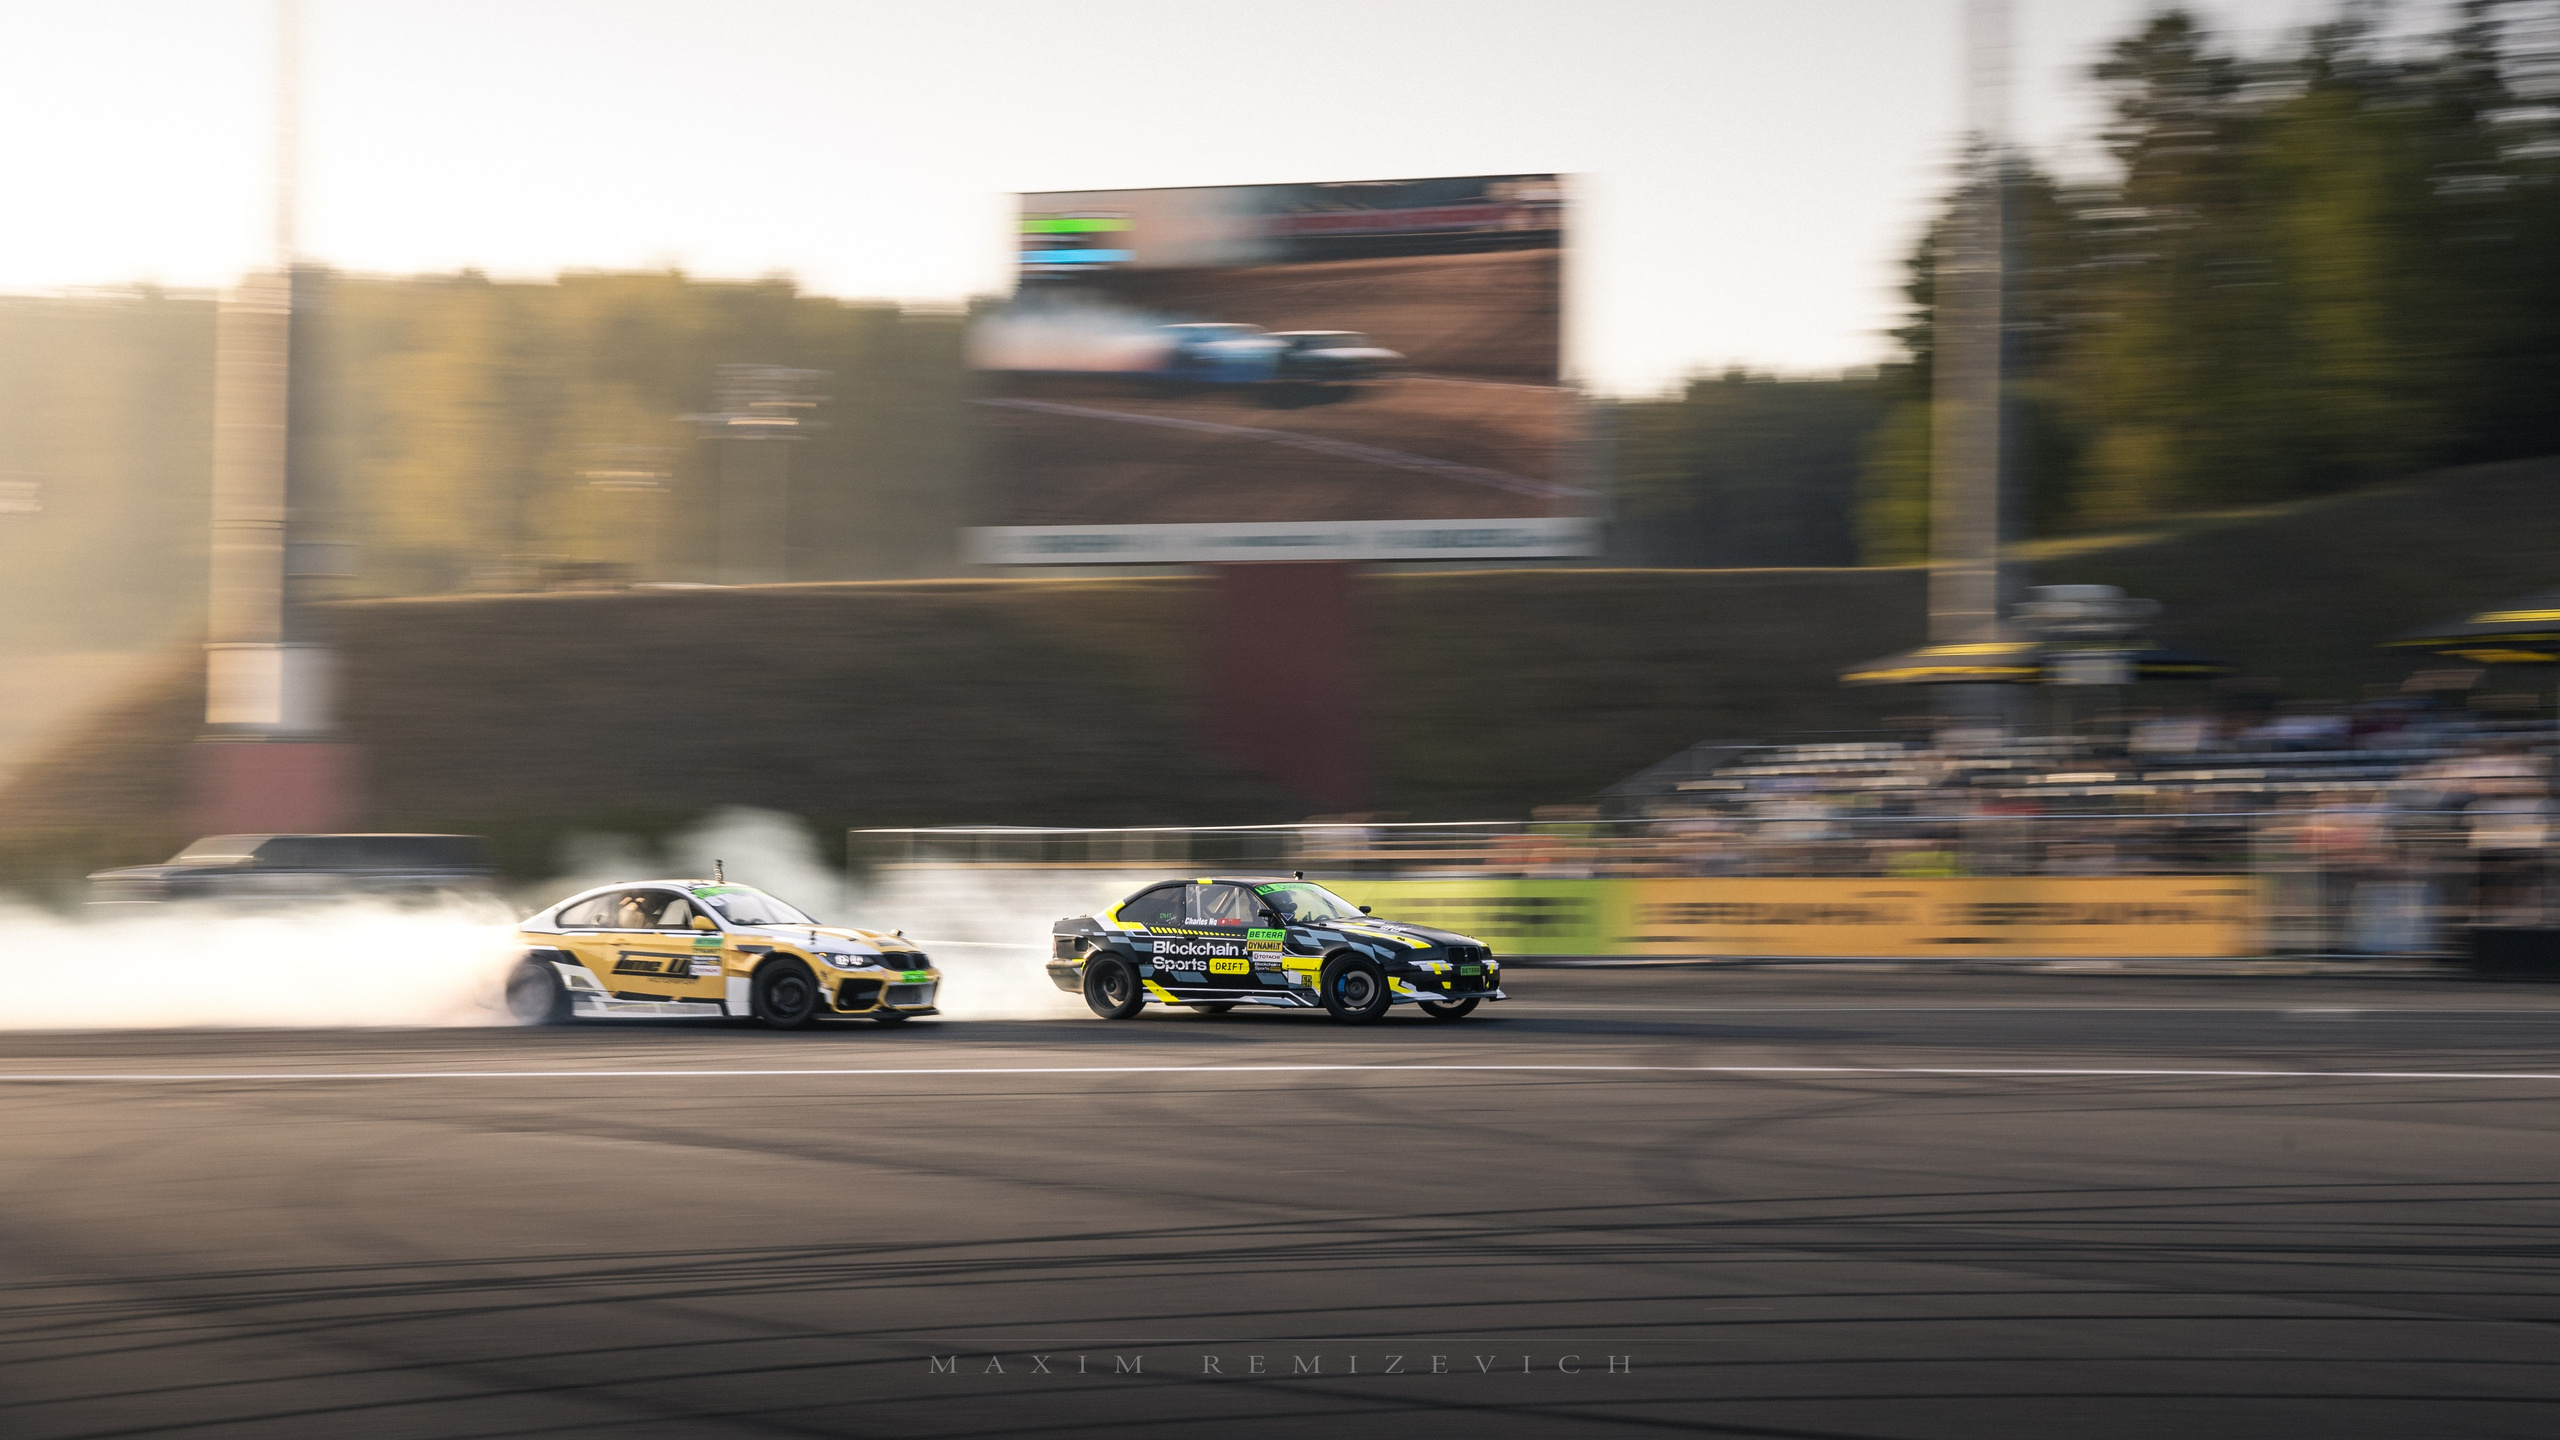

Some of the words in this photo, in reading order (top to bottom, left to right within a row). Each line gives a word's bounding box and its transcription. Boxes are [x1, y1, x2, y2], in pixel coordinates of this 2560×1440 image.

[1184, 917, 1208, 926] Charles
[1153, 940, 1239, 956] Blockchain
[1152, 956, 1207, 972] Sports
[1215, 962, 1244, 971] DRIFT
